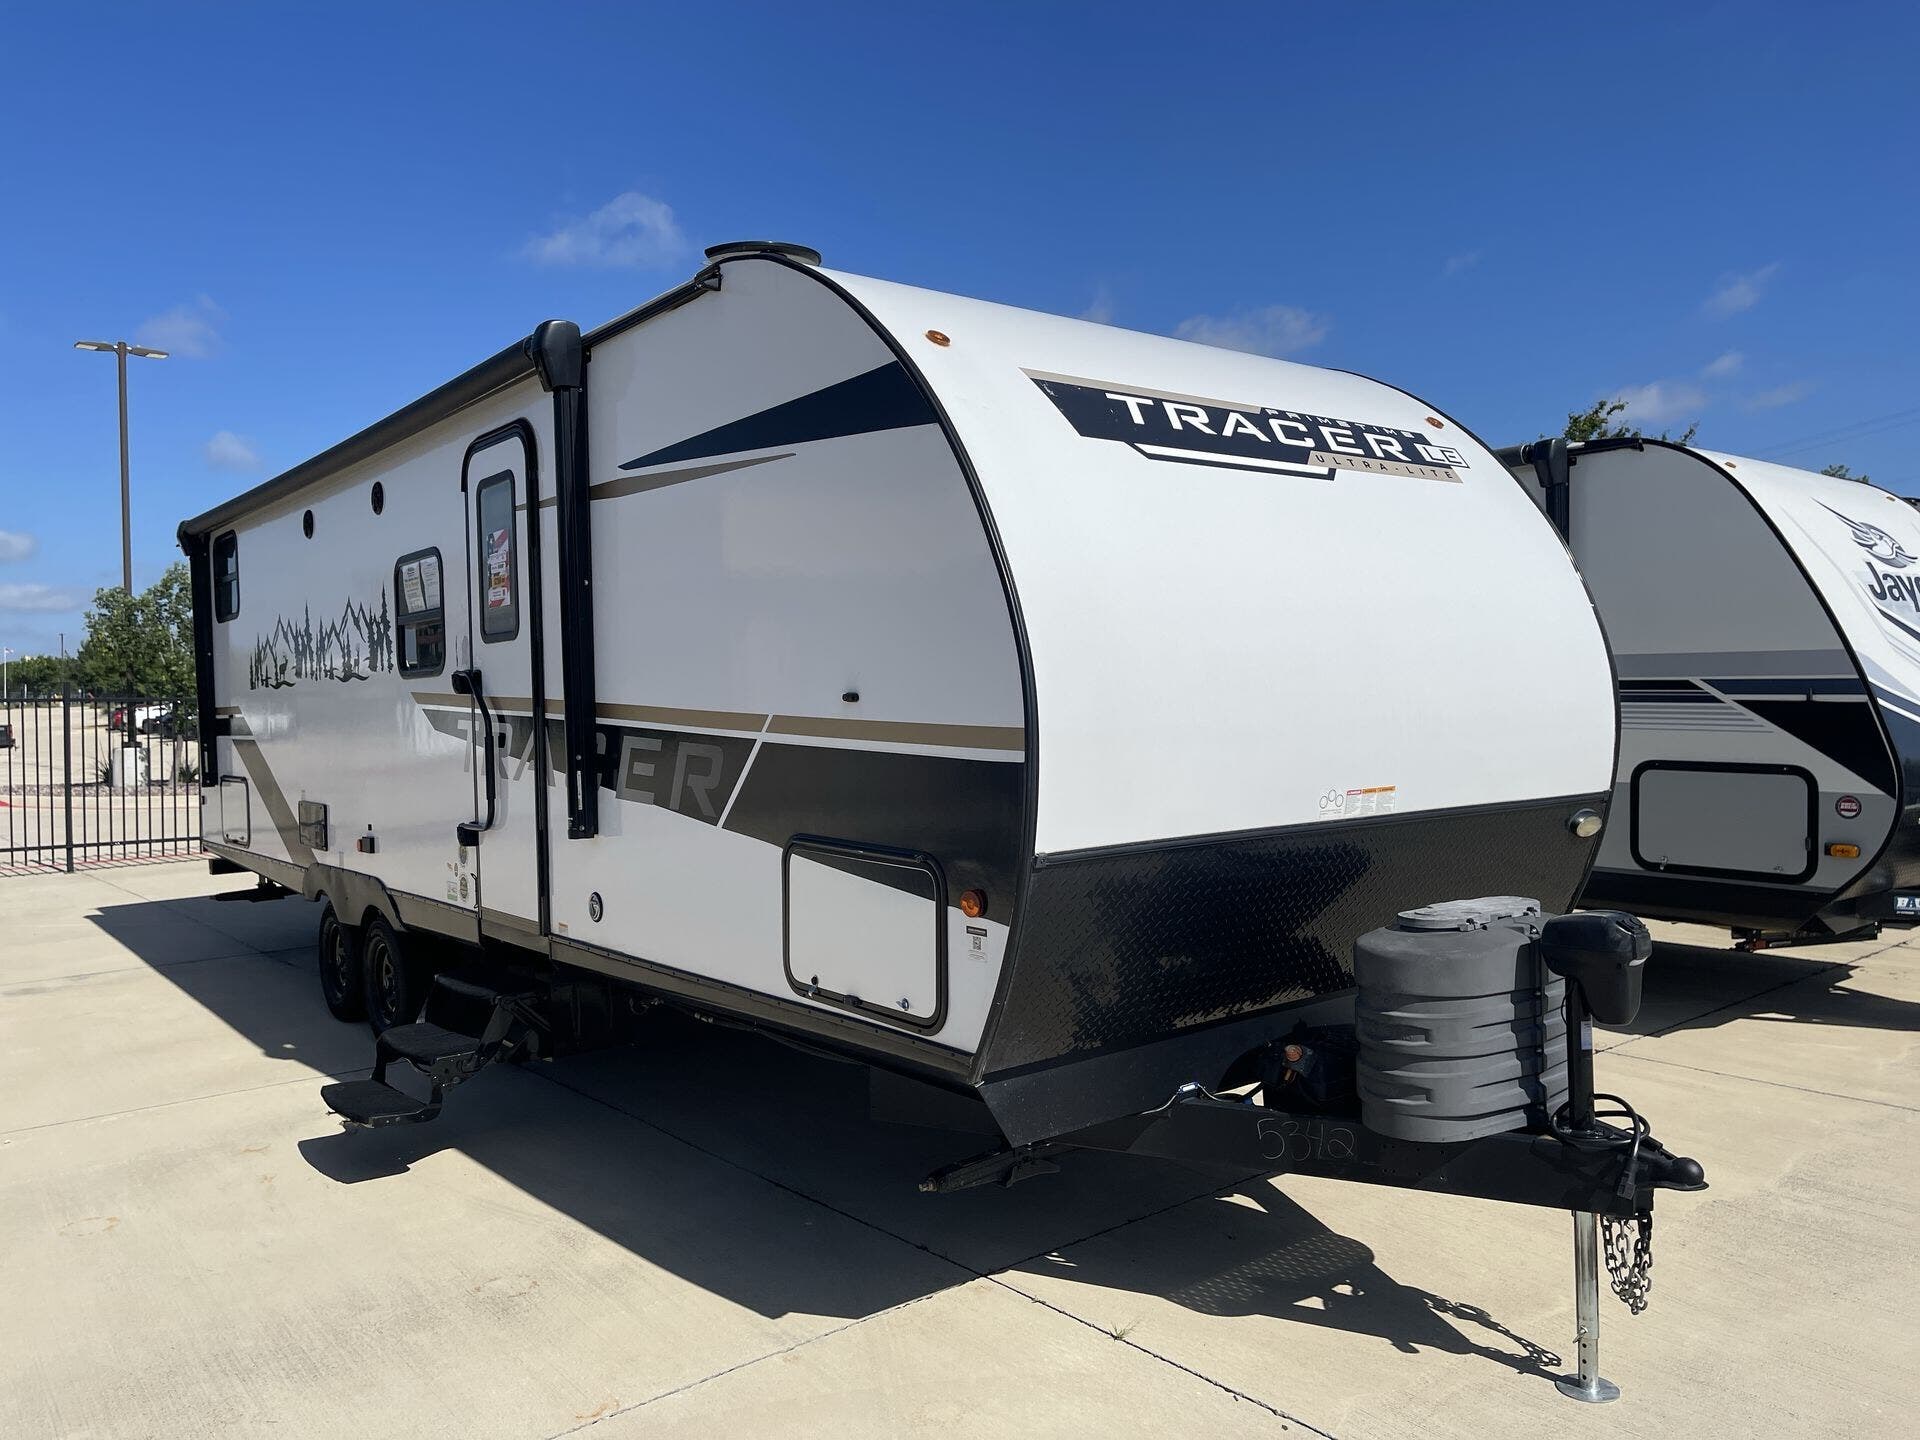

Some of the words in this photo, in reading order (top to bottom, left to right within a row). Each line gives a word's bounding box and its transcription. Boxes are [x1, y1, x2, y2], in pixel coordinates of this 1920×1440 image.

[1105, 392, 1411, 462] TRACER
[1422, 446, 1463, 465] LE
[1315, 454, 1453, 479] ULTRA-LITE
